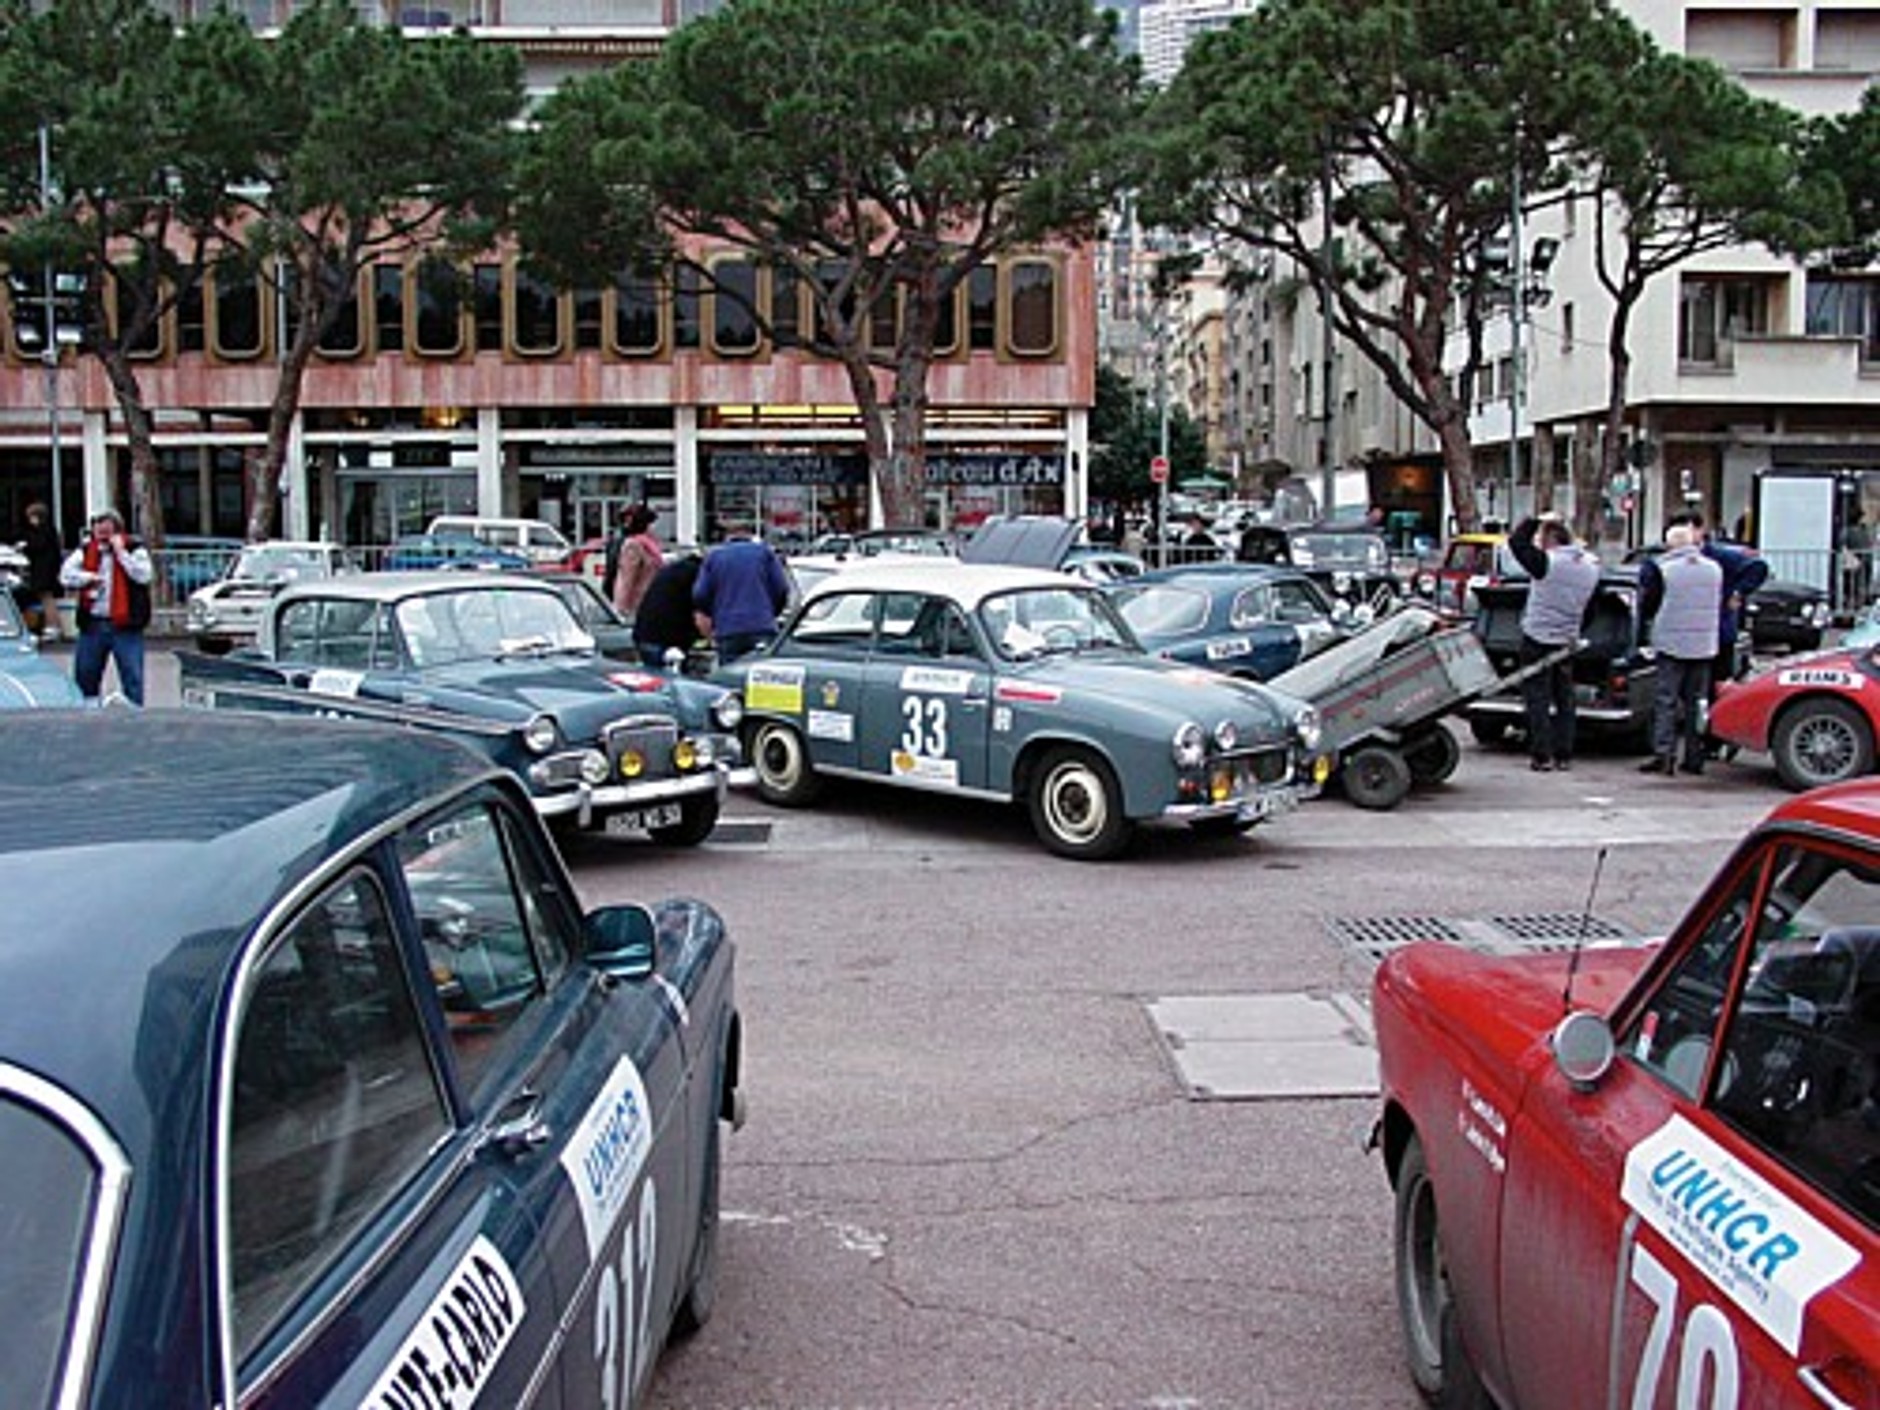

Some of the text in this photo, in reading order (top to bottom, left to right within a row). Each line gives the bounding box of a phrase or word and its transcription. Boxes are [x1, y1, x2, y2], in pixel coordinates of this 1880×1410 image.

[1789, 671, 1852, 686] REIMS
[902, 696, 946, 758] 33
[583, 1089, 639, 1197] UNHCR
[1651, 1149, 1799, 1280] UNHCR
